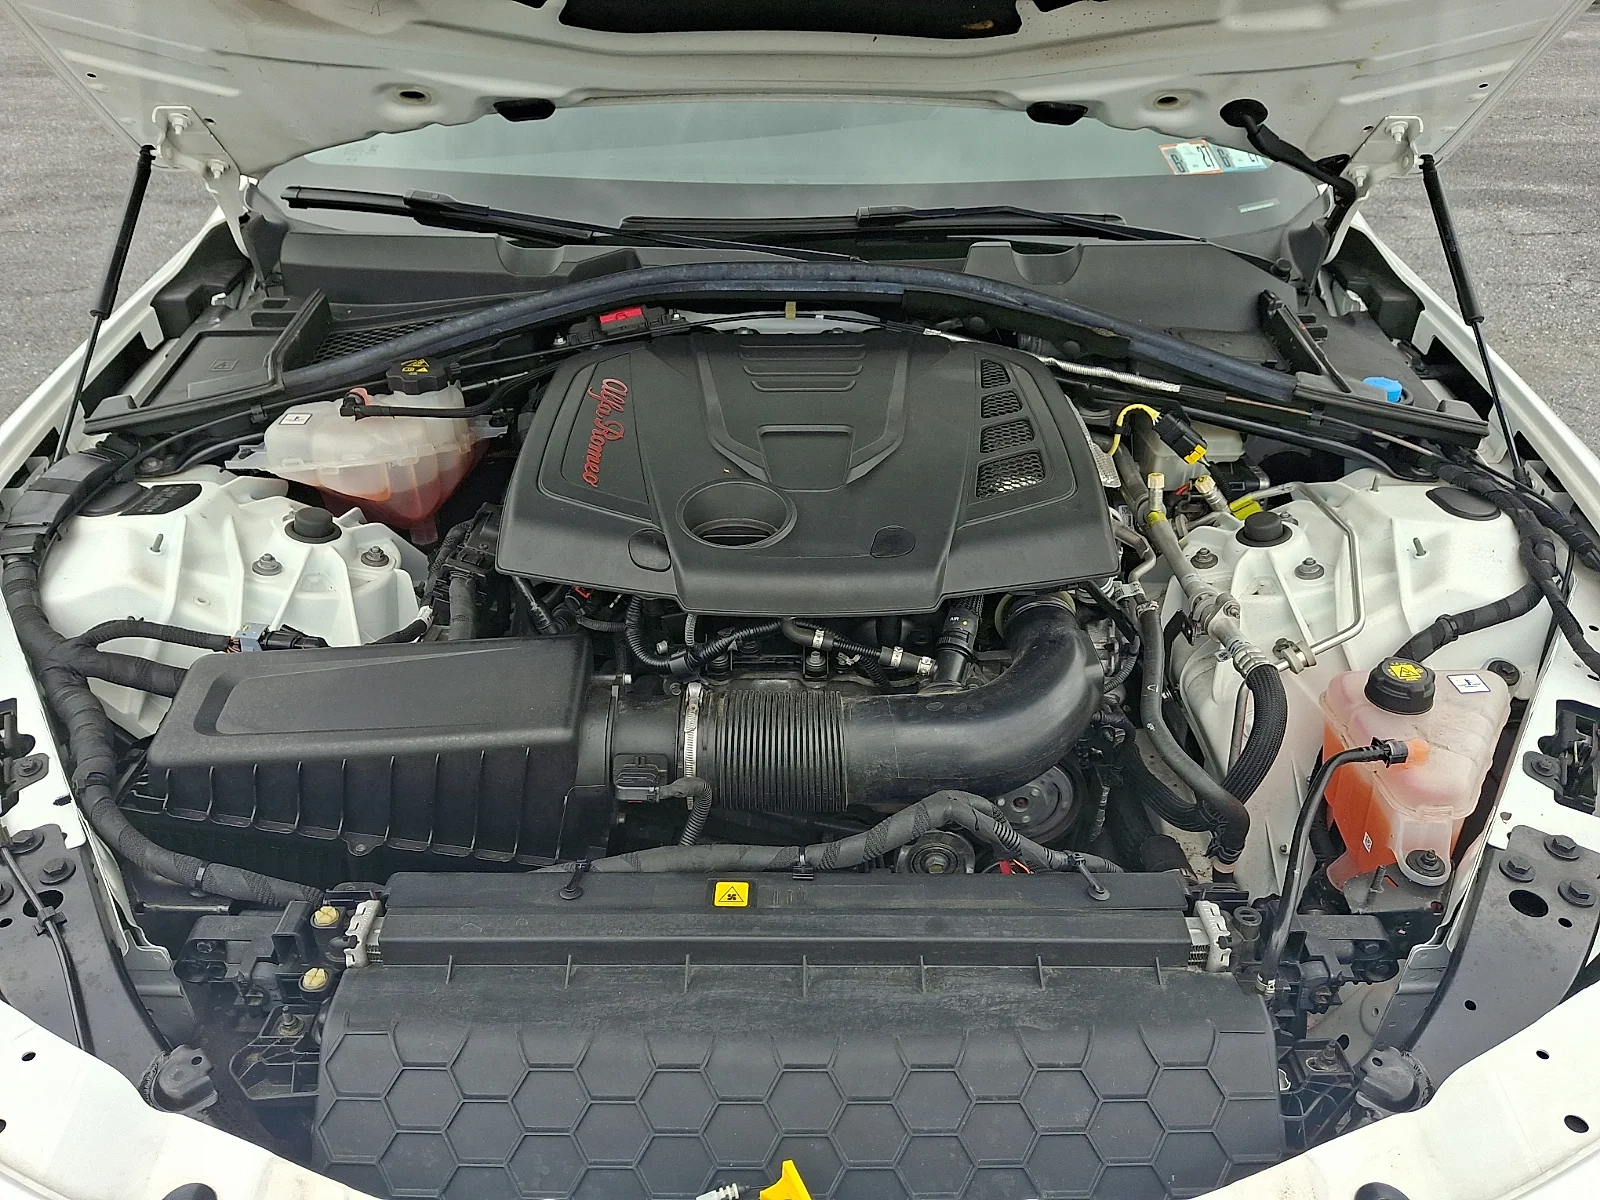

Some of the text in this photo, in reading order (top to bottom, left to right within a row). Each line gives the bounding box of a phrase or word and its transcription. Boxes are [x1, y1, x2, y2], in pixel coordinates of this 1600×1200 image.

[1196, 145, 1215, 169] 27
[583, 378, 628, 488] Alfa Romeo
